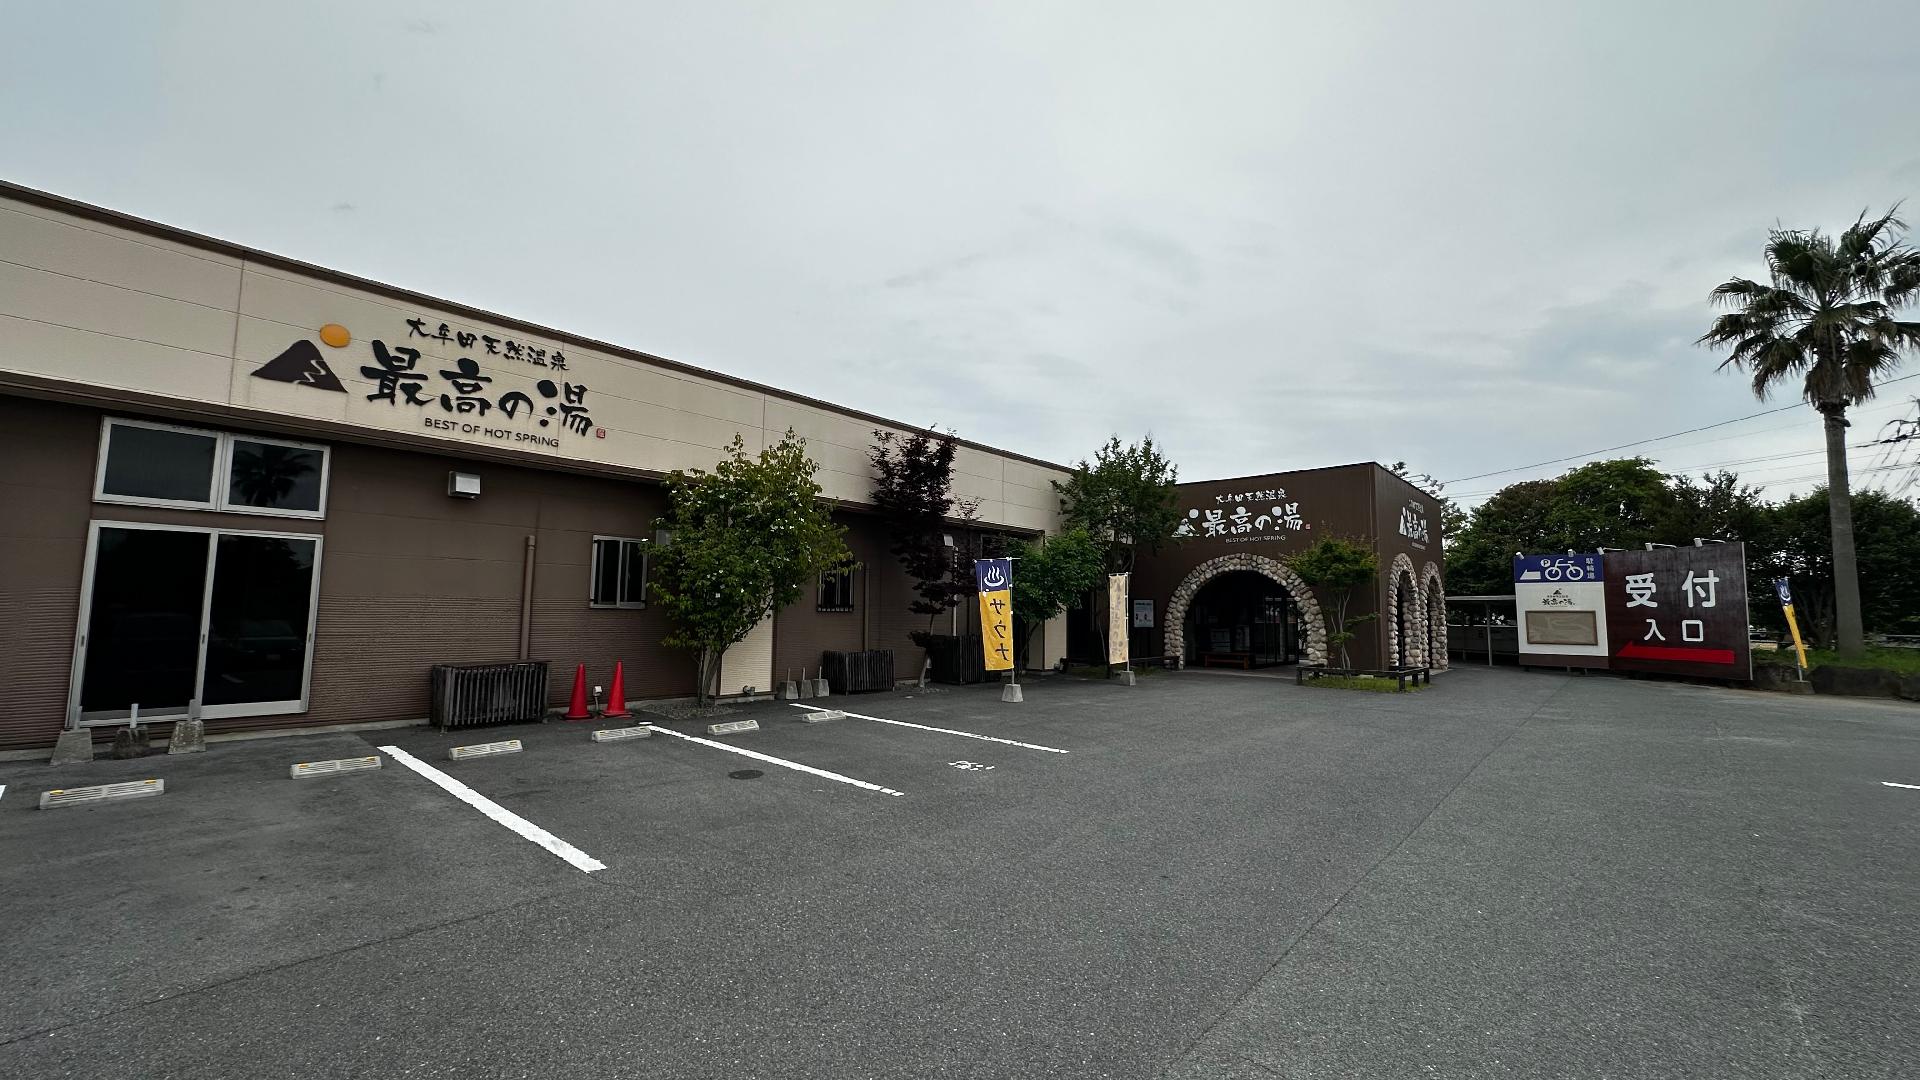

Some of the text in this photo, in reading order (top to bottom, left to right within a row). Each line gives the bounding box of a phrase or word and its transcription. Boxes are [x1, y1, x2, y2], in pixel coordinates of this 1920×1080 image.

[406, 317, 570, 372] 大牟田天然温泉
[360, 339, 594, 438] 最高の湯
[425, 417, 559, 448] BEST OF HOT SPRING
[1215, 488, 1287, 504] 大牟田天然温泉
[1201, 502, 1303, 538] 最高の湯
[1625, 569, 1720, 608] 受付
[989, 598, 1010, 662] サウナ
[1643, 618, 1704, 642] 入口
